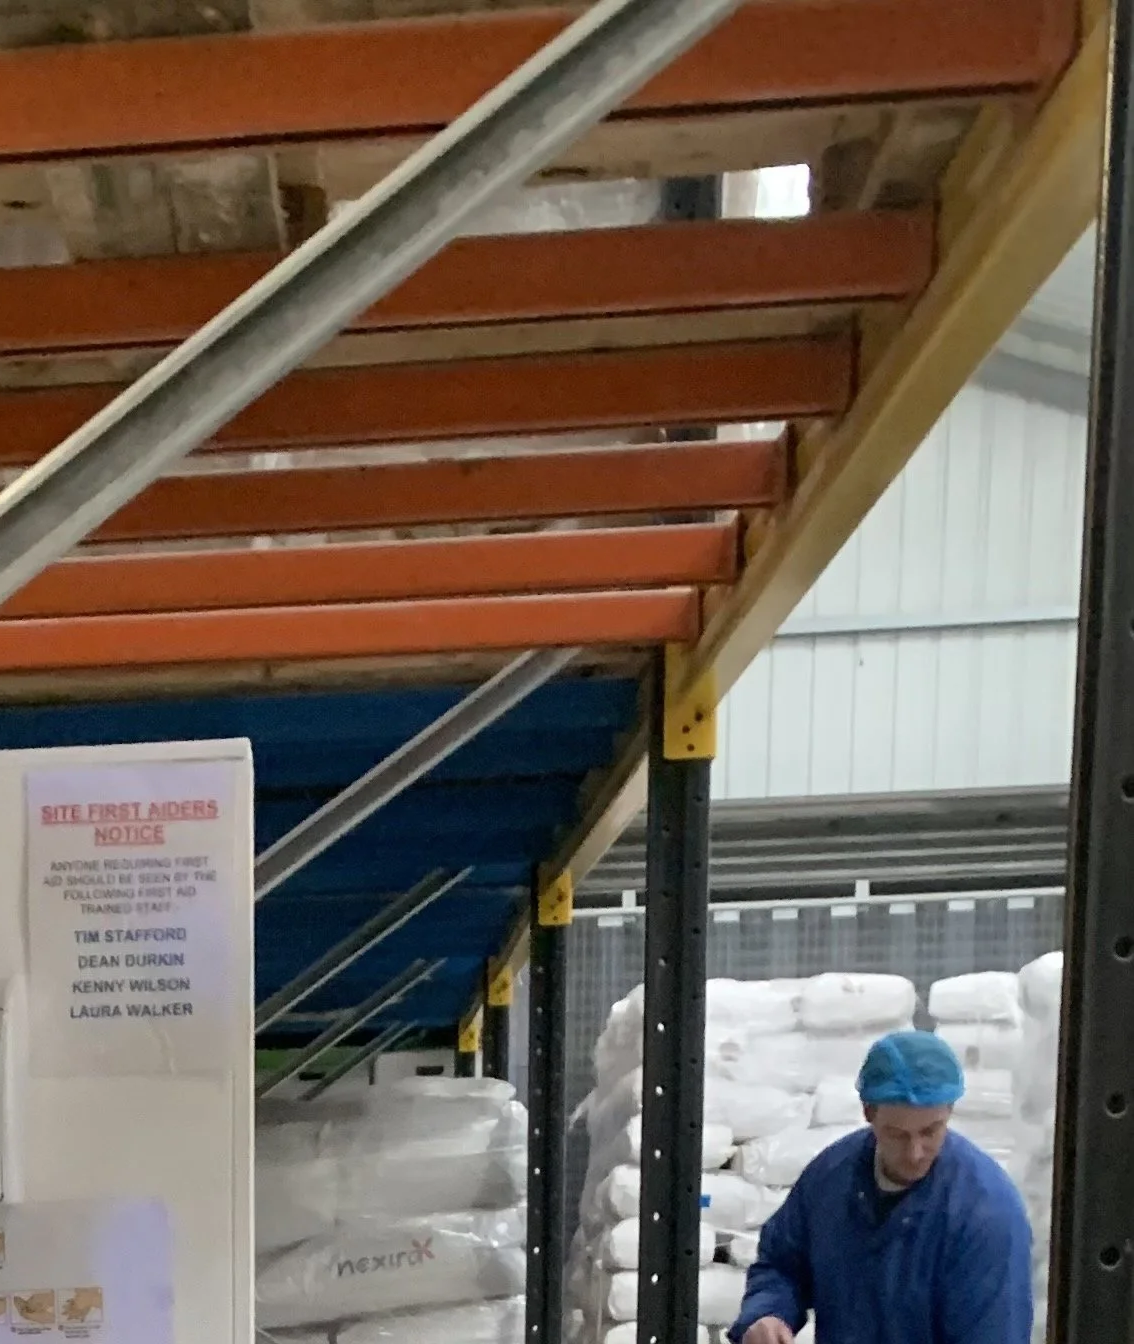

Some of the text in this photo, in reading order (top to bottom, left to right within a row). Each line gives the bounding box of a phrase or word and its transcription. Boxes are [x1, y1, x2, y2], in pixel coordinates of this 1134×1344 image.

[41, 800, 219, 822] SITE FIRST AIDERS
[95, 825, 165, 843] NOTICE
[50, 860, 99, 871] ANYONE
[175, 856, 209, 868] FIRST
[66, 874, 115, 886] SHOULD
[119, 873, 133, 884] BE
[138, 872, 171, 884] SEEN
[63, 886, 197, 900] FOLLOWING FIRST AID
[80, 903, 132, 914] TRAINED
[74, 928, 186, 943] TIM STAFFORD
[78, 953, 185, 969] DEAN DURKIN
[72, 977, 190, 993] KENNY WILSON
[70, 1002, 193, 1018] LAURA WALKER
